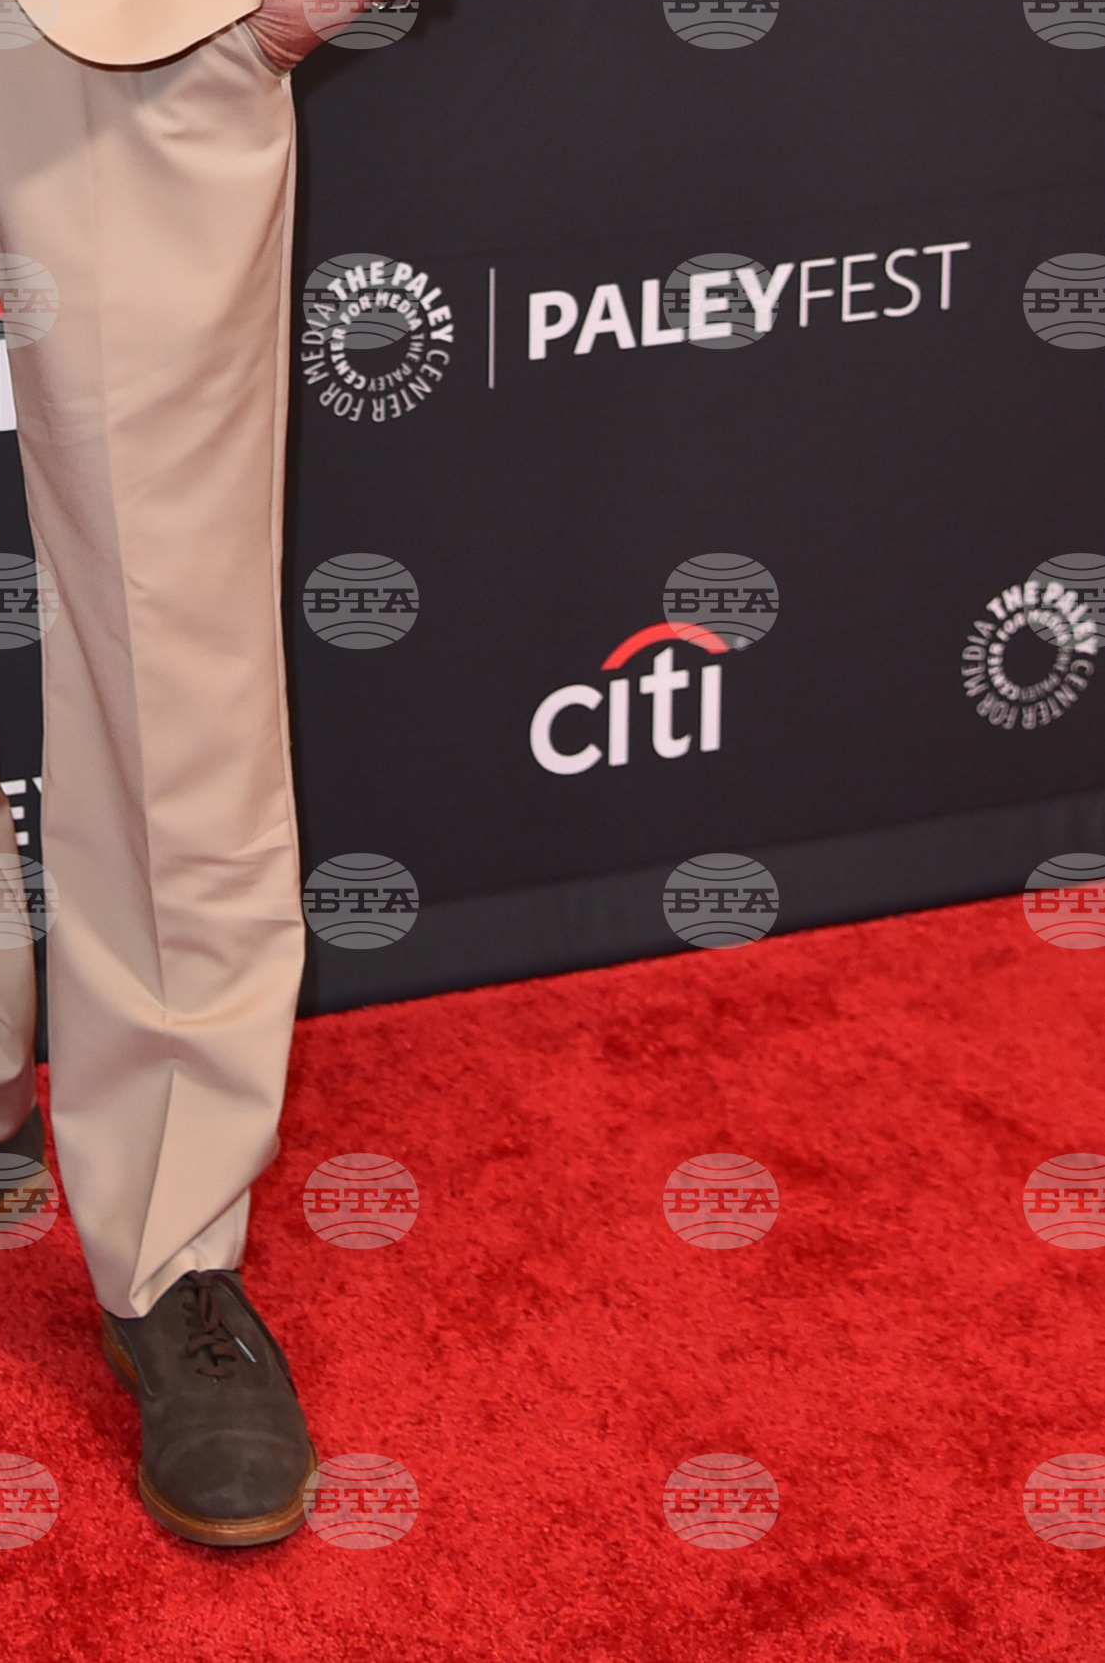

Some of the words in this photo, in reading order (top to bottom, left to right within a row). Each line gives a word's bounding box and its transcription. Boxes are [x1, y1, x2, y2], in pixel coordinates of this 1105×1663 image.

[327, 261, 385, 301] THE
[391, 262, 454, 343] PALEY
[528, 241, 970, 361] PALEYFEST
[301, 303, 336, 384] MEDIA
[319, 382, 364, 421] FOR
[372, 349, 450, 422] CENTER
[530, 647, 722, 775] citi
